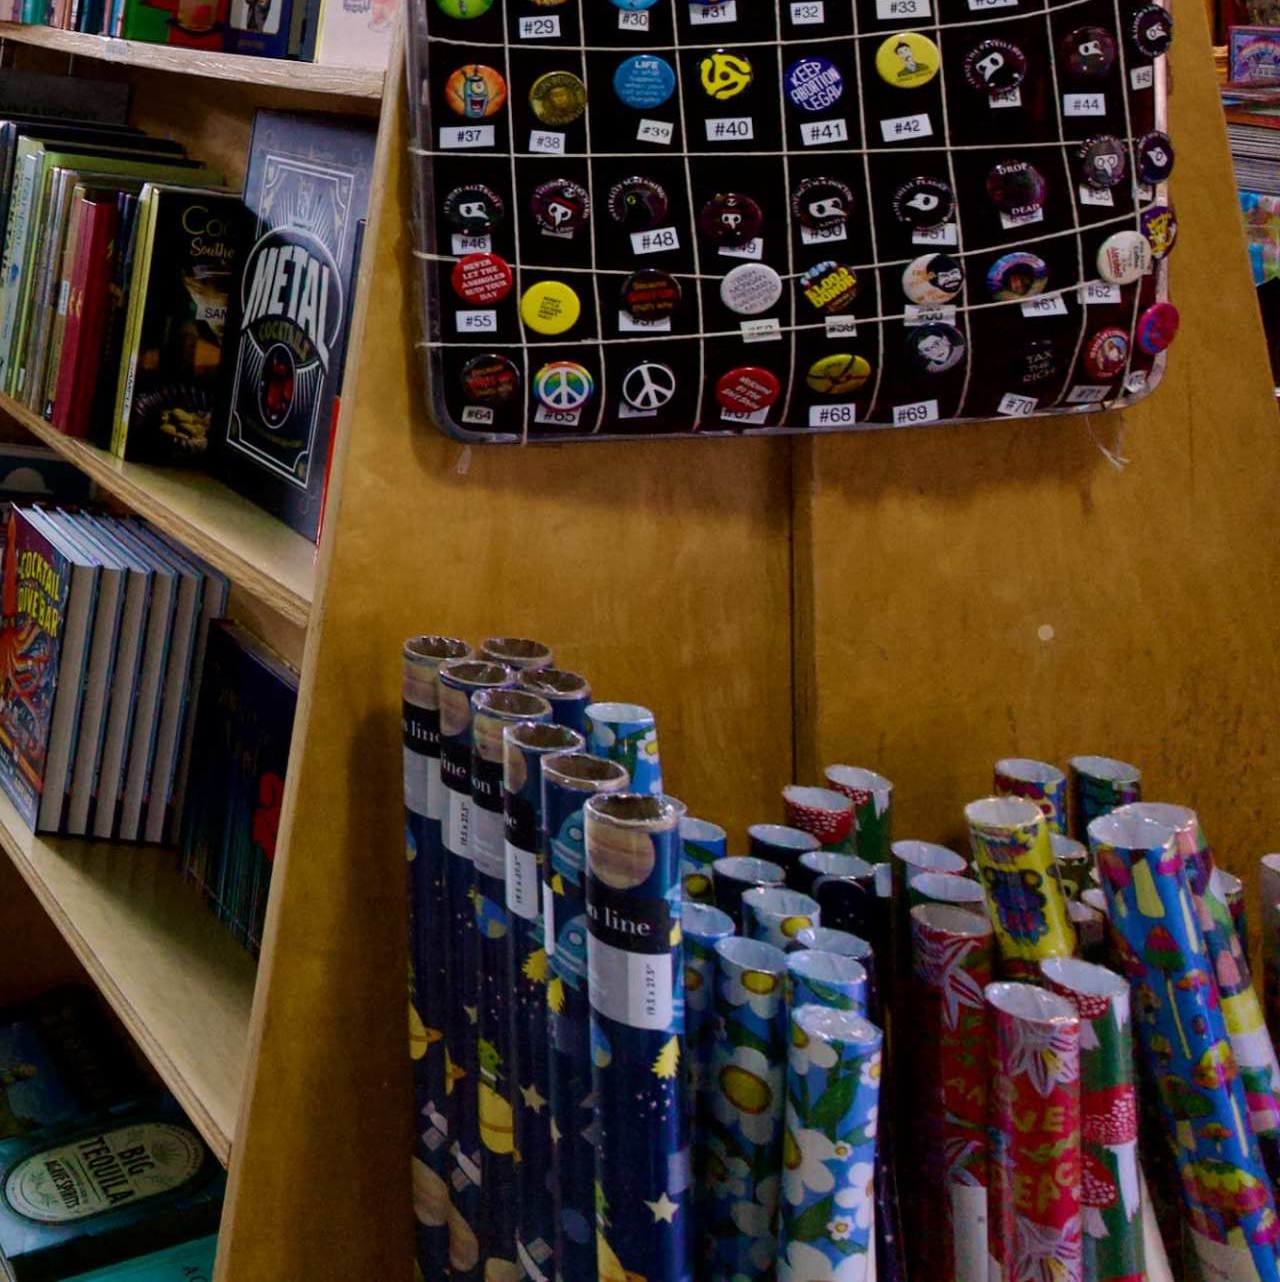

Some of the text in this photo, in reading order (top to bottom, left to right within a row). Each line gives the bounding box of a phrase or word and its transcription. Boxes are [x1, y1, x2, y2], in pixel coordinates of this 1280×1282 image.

[701, 4, 726, 17] #31
[794, 6, 818, 18] #32
[889, 1, 917, 14] #33
[524, 20, 555, 35] #29
[790, 62, 822, 87] KEEP
[790, 68, 841, 104] ABORTION
[802, 84, 843, 110] LEGAL
[1073, 99, 1100, 110] #44
[642, 126, 670, 139] #39
[715, 122, 749, 137] #40
[810, 124, 843, 140] #41
[894, 119, 921, 134] #42
[457, 130, 482, 143] #37
[536, 137, 561, 149] #38
[1011, 203, 1040, 215] DEAD
[461, 237, 487, 250] #46
[641, 232, 675, 247] #48
[463, 259, 492, 271] NEVER
[463, 270, 479, 281] LET
[479, 290, 497, 302] DAY
[1087, 286, 1111, 298] #62
[241, 245, 331, 375] METAL
[465, 315, 492, 327] #55
[467, 408, 491, 419] #64
[897, 405, 928, 421] #69
[1006, 400, 1033, 414] #70
[819, 406, 852, 423] #68
[19, 550, 61, 602] COCKTAIL
[17, 586, 60, 638] DIVE BAR
[605, 905, 652, 937] line
[118, 1144, 155, 1176] BIG
[78, 1134, 136, 1204] TEQUILA
